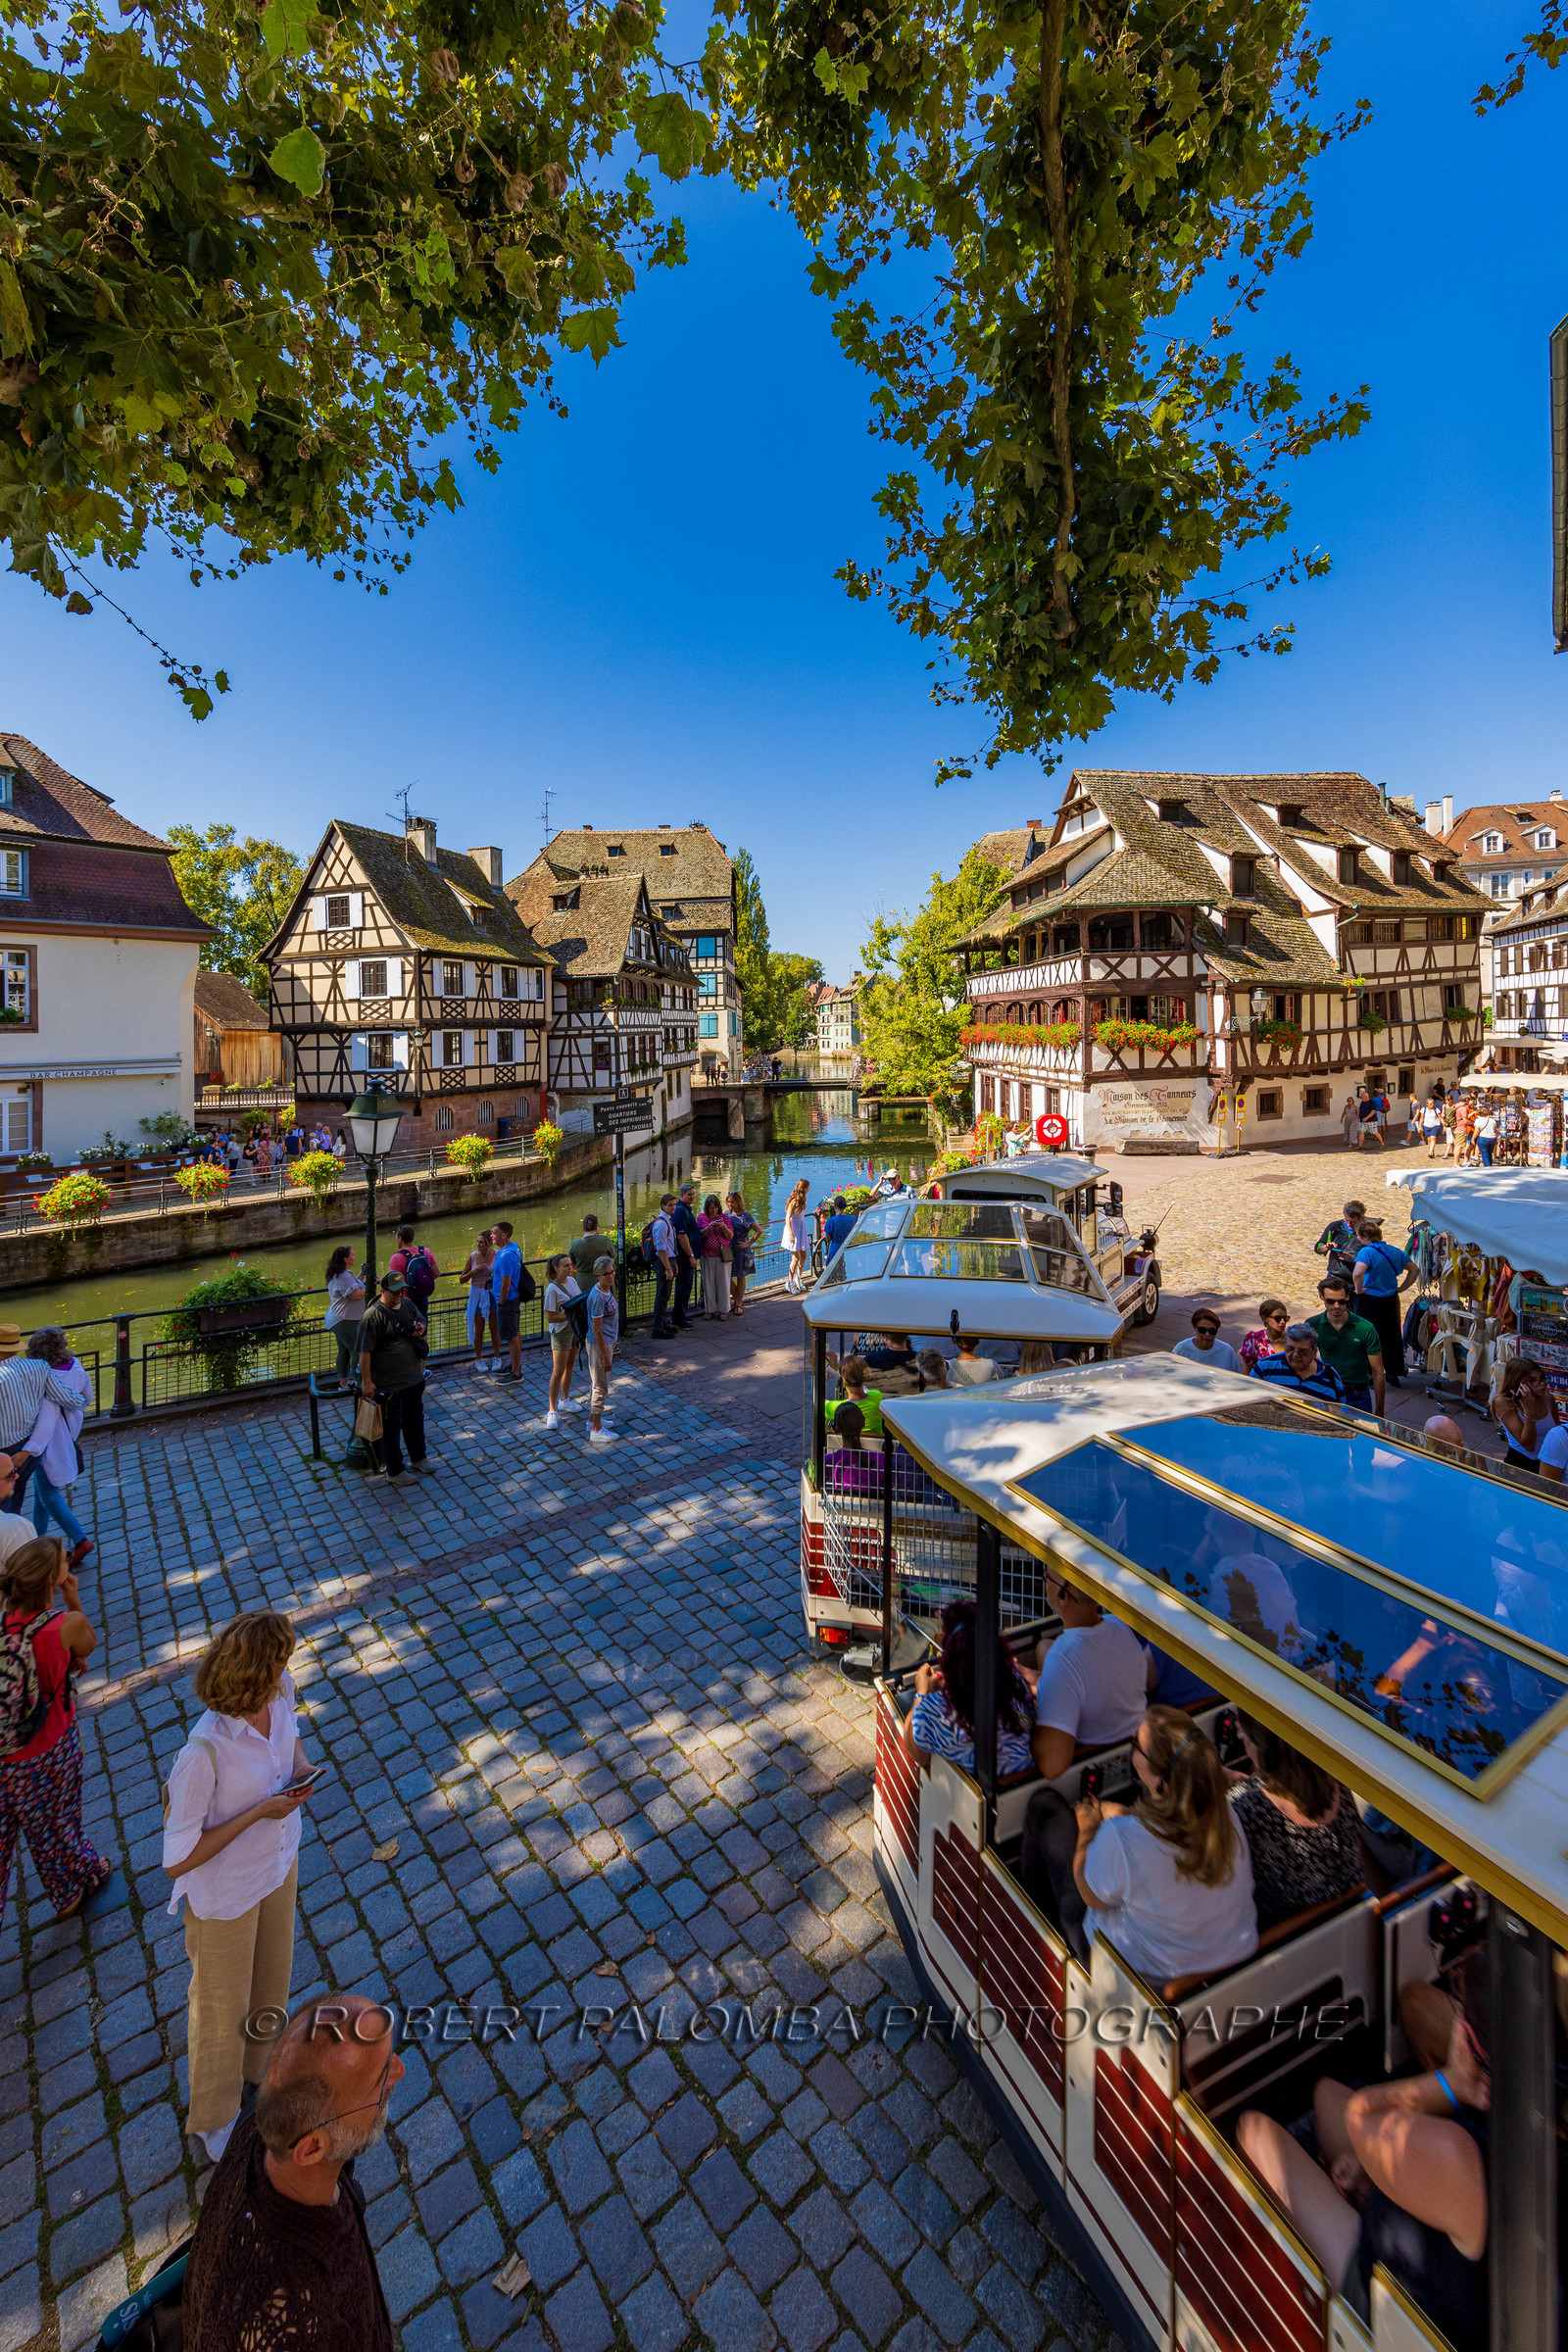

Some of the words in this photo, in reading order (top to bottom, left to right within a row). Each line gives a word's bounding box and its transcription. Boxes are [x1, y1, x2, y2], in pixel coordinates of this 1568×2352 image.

[55, 1069, 118, 1078] CHAMPAGNE
[1098, 1088, 1134, 1104] Maison
[1135, 1090, 1149, 1101] des
[1150, 1085, 1198, 1102] Tanneurs
[608, 1109, 637, 1119] QUARTIERS
[619, 1114, 652, 1124] IMPRIMEURS
[614, 1122, 653, 1133] SAINT-THOMAS
